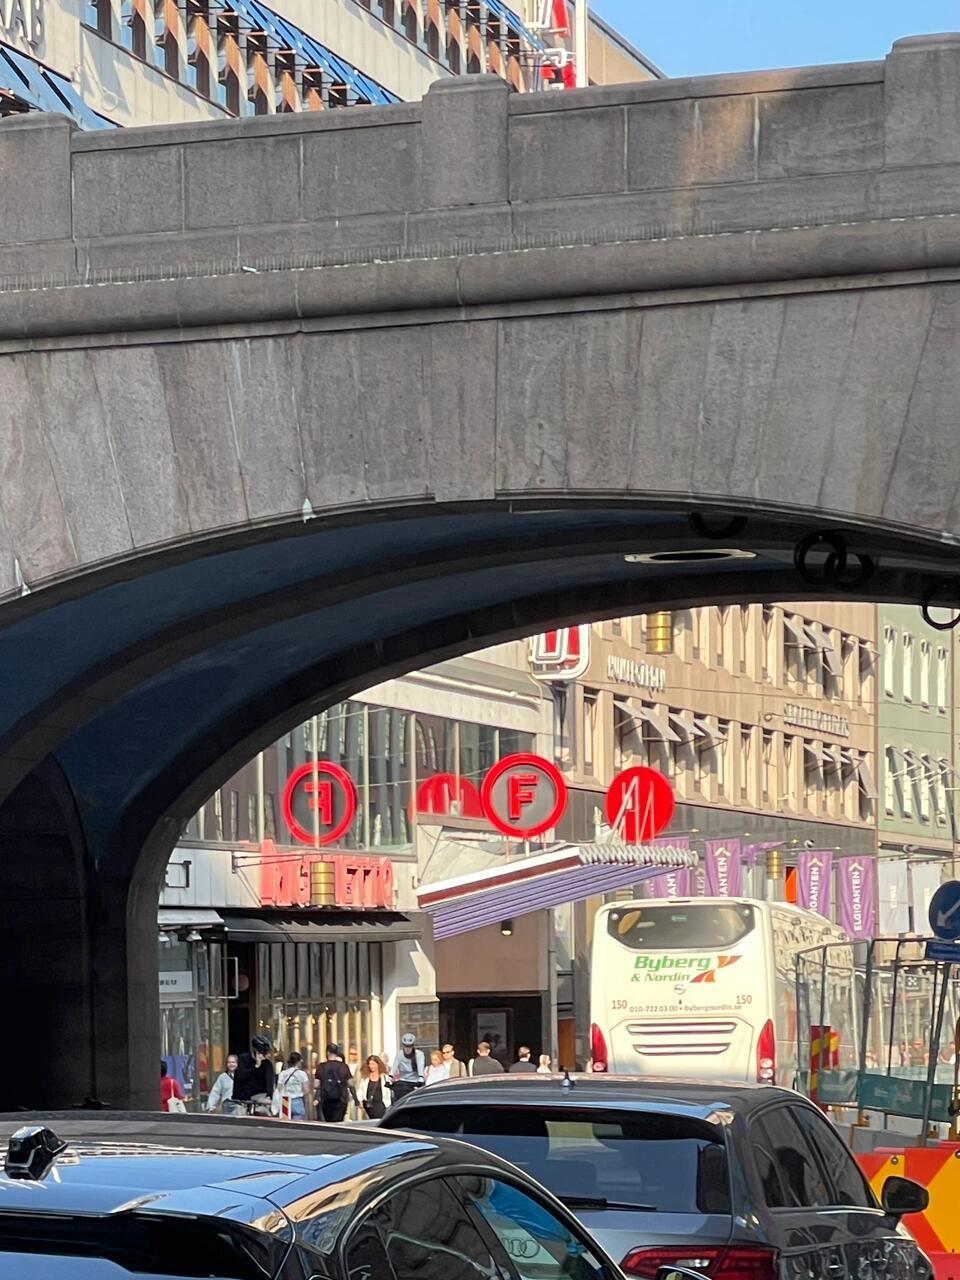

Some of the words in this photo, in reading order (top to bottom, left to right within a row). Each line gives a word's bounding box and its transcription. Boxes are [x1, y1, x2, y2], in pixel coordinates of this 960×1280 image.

[509, 774, 538, 820] F
[852, 872, 862, 931] ELGIGANTEN
[634, 955, 712, 972] Byberg
[630, 973, 641, 982] &
[645, 972, 690, 982] Nordin
[612, 1000, 628, 1010] 150
[736, 995, 752, 1005] 150
